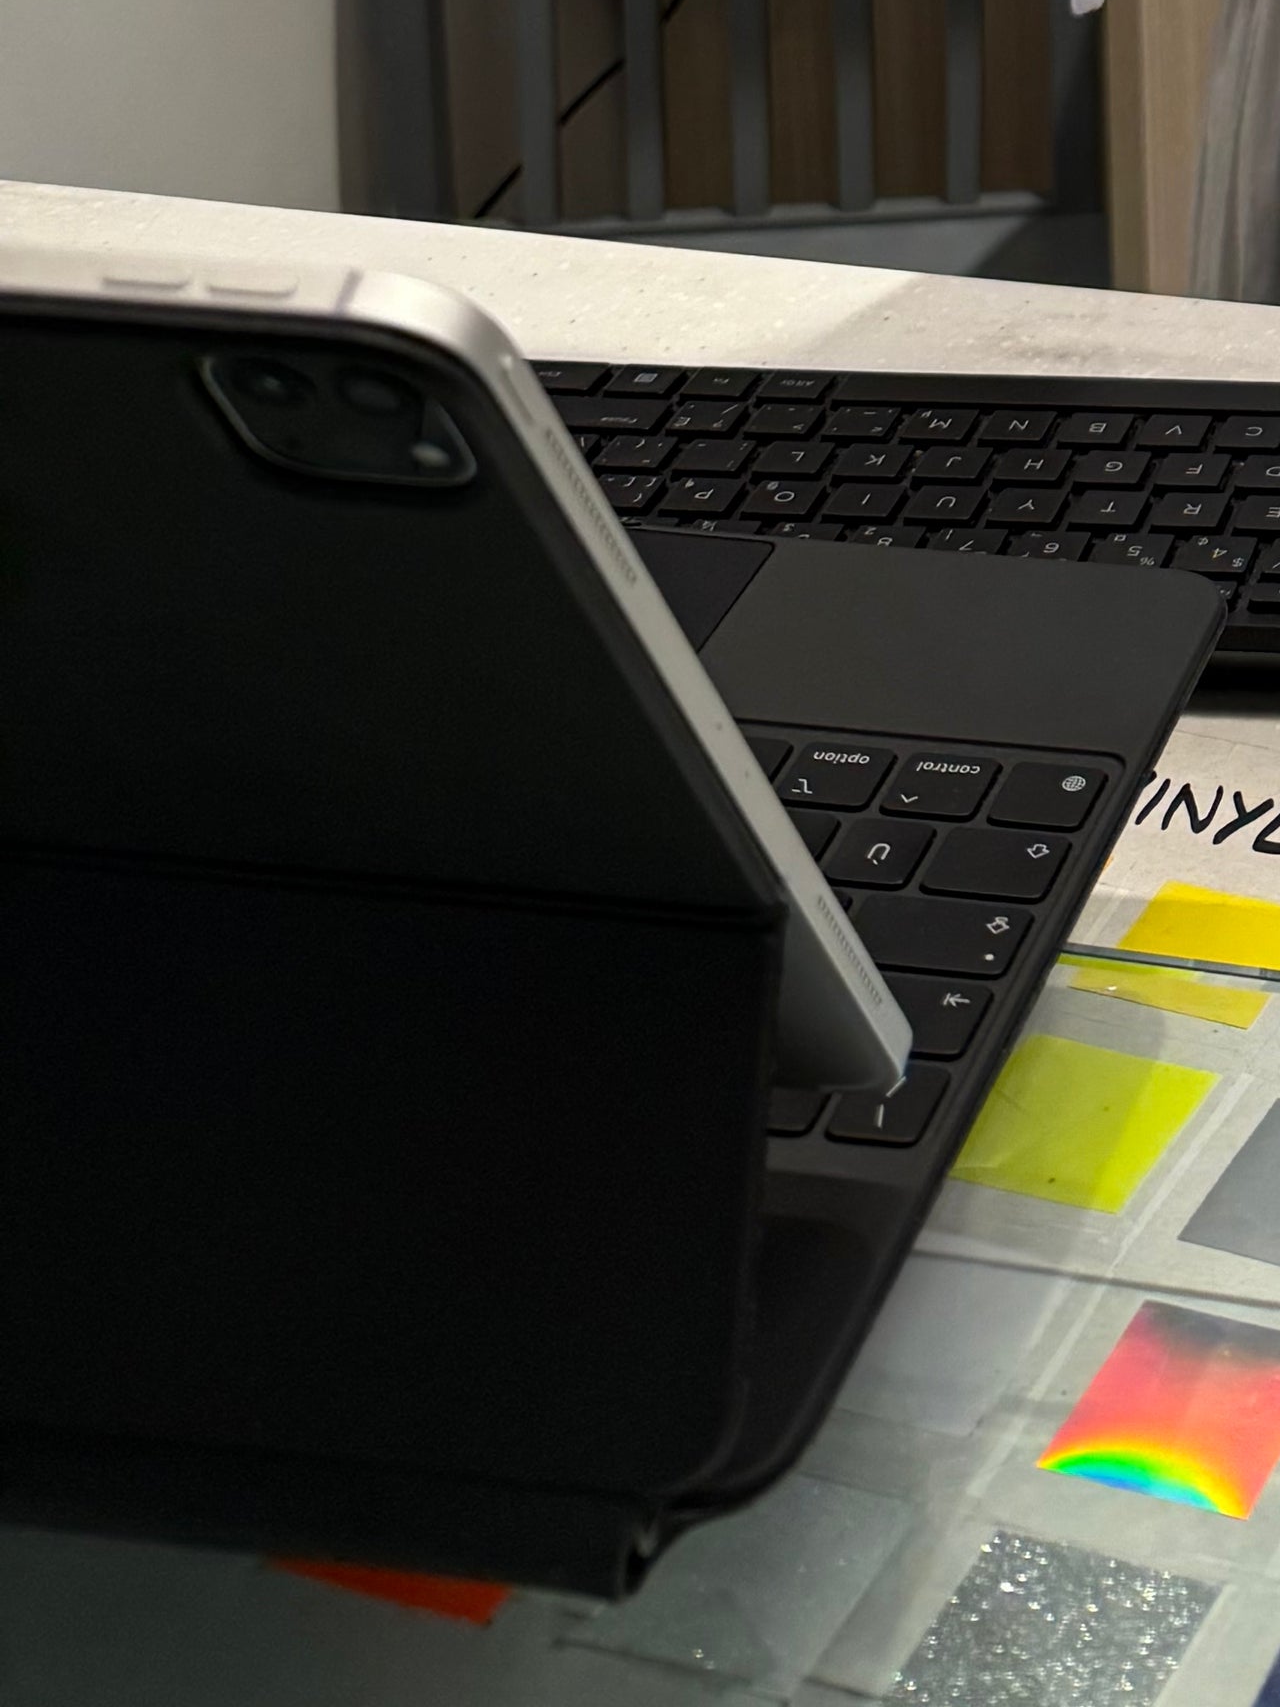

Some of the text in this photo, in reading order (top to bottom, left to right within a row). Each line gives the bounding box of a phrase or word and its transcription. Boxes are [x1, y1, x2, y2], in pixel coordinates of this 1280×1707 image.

[930, 419, 952, 429] M
[1009, 420, 1028, 429] N
[1090, 423, 1106, 432] B
[1166, 426, 1181, 434] V
[1246, 427, 1262, 436] C
[792, 452, 804, 461] L
[866, 455, 885, 465] K
[947, 457, 961, 466] J
[1024, 459, 1043, 469] H
[1105, 462, 1122, 471] G
[1186, 464, 1202, 474] F
[693, 489, 713, 499] P
[774, 491, 794, 501] O
[937, 497, 955, 507] U
[1018, 500, 1034, 509] Y
[1101, 502, 1113, 512] T
[1184, 504, 1201, 514] R
[813, 749, 871, 766] option
[915, 759, 982, 775] control
